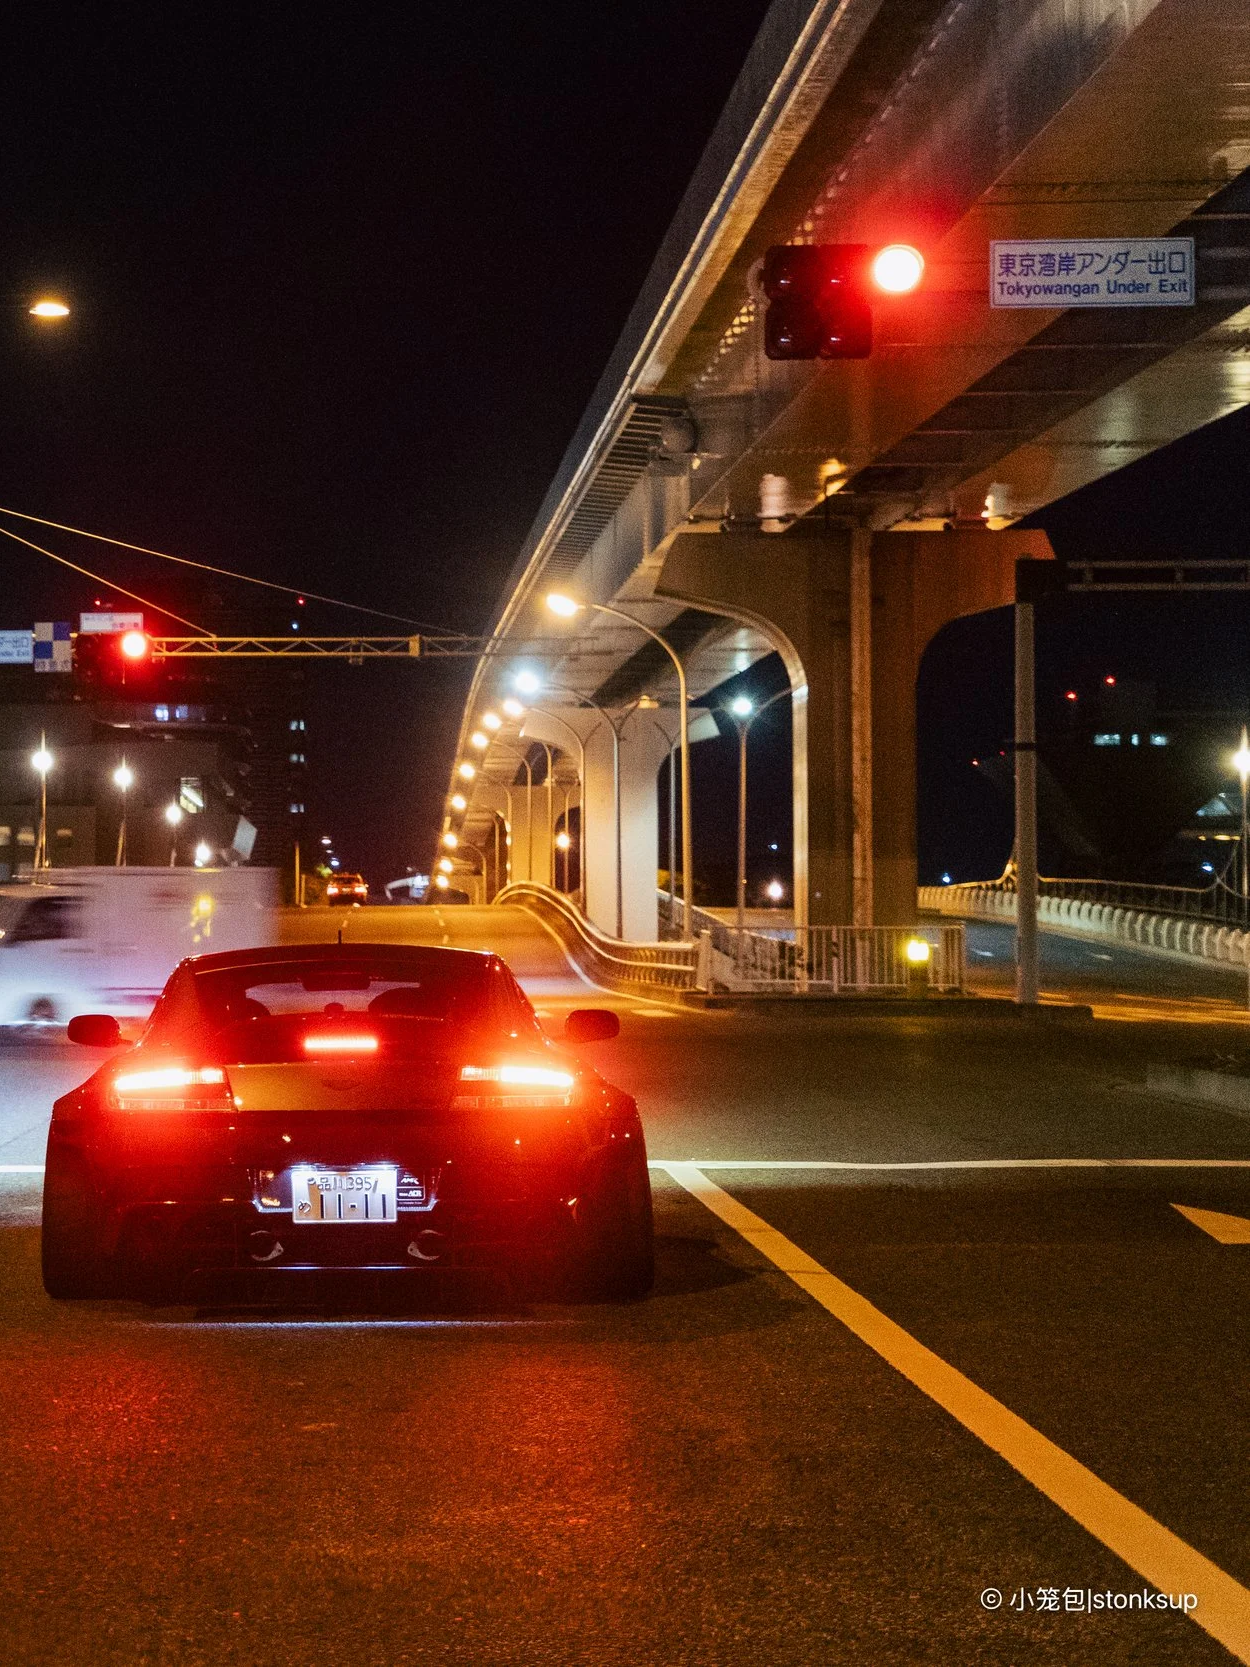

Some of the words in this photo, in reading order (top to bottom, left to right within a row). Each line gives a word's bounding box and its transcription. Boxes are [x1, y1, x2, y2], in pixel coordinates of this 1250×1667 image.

[998, 250, 1186, 277] 東京湾岸アンダー出口
[997, 281, 1099, 298] Tokyowangan
[1106, 279, 1150, 295] Under
[1158, 278, 1188, 293] Exit
[320, 1194, 386, 1219] 11-11
